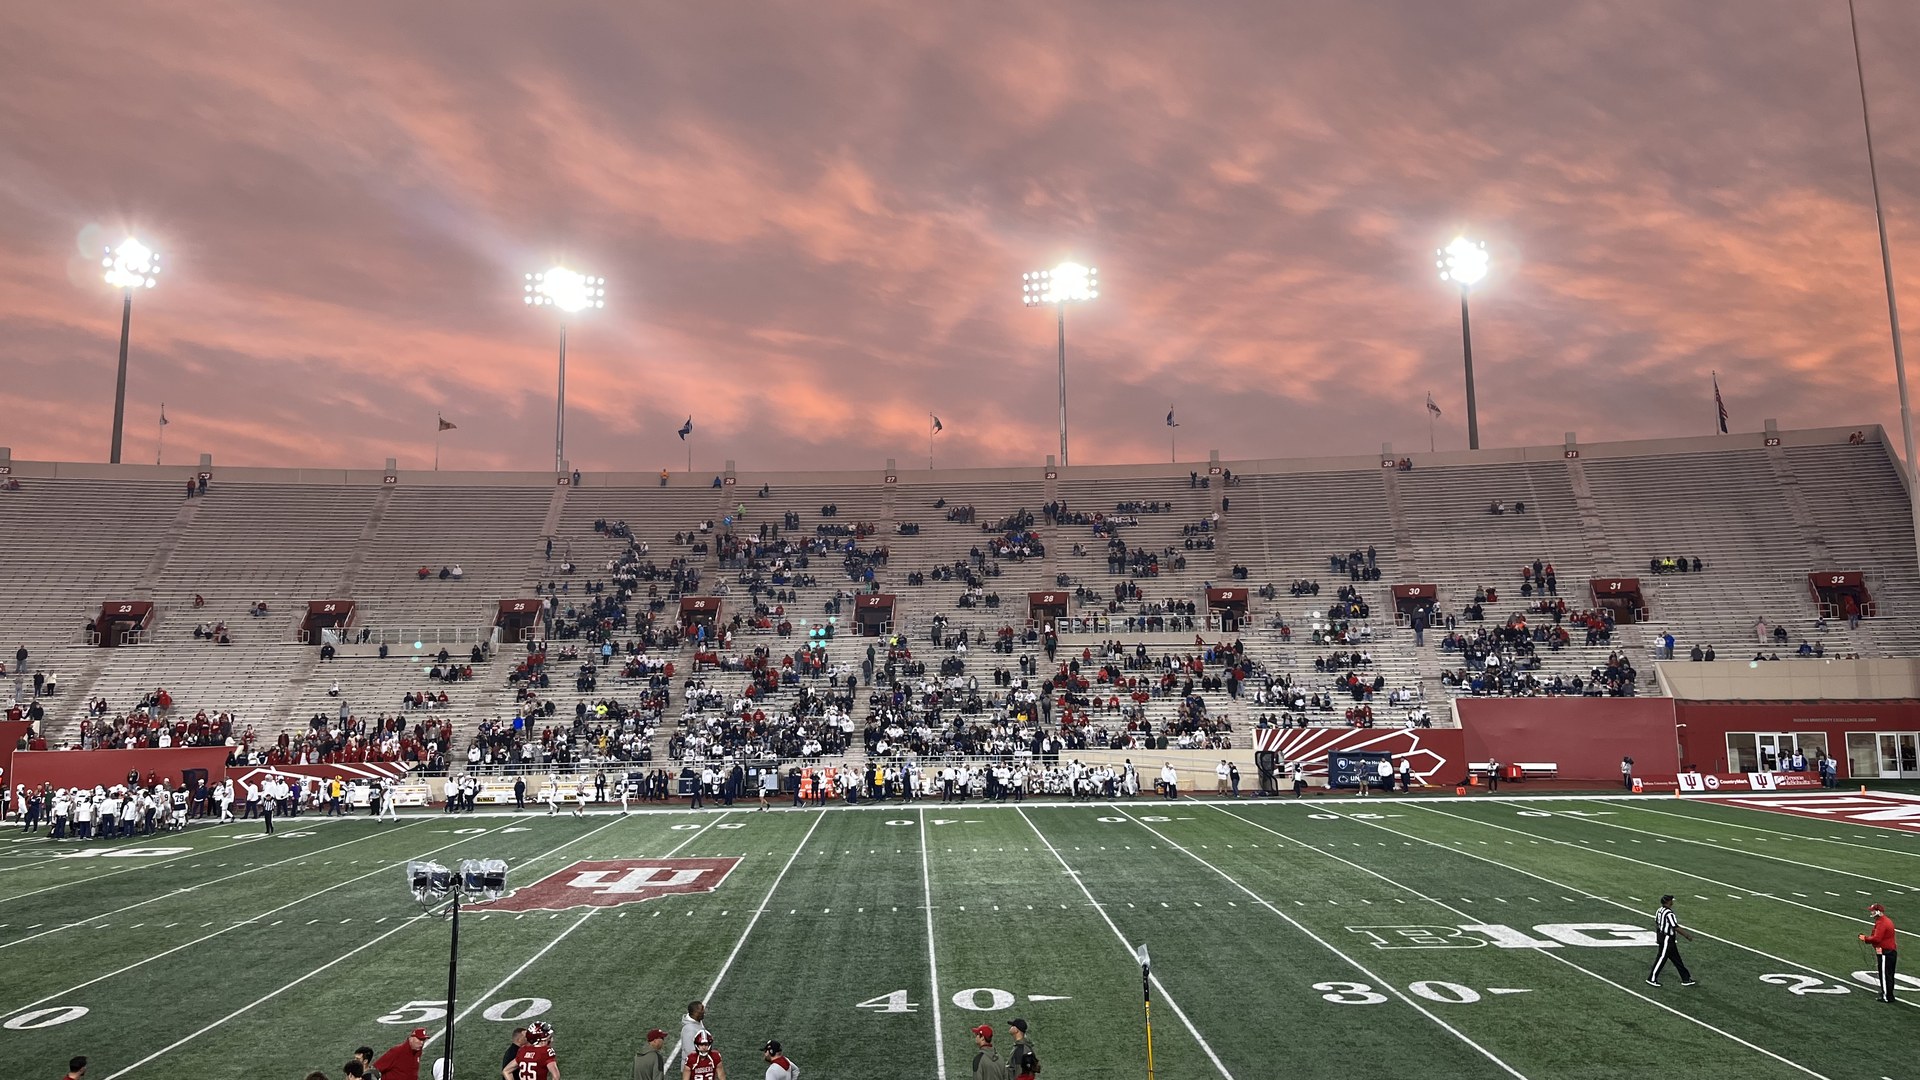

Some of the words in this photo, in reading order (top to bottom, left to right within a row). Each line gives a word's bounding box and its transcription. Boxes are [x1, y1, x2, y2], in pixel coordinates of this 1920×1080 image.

[1831, 576, 1845, 584] 32
[1610, 582, 1621, 590] 31
[694, 600, 704, 608] 26
[119, 605, 131, 613] 23
[175, 794, 185, 803] 79
[518, 1061, 538, 1080] 25
